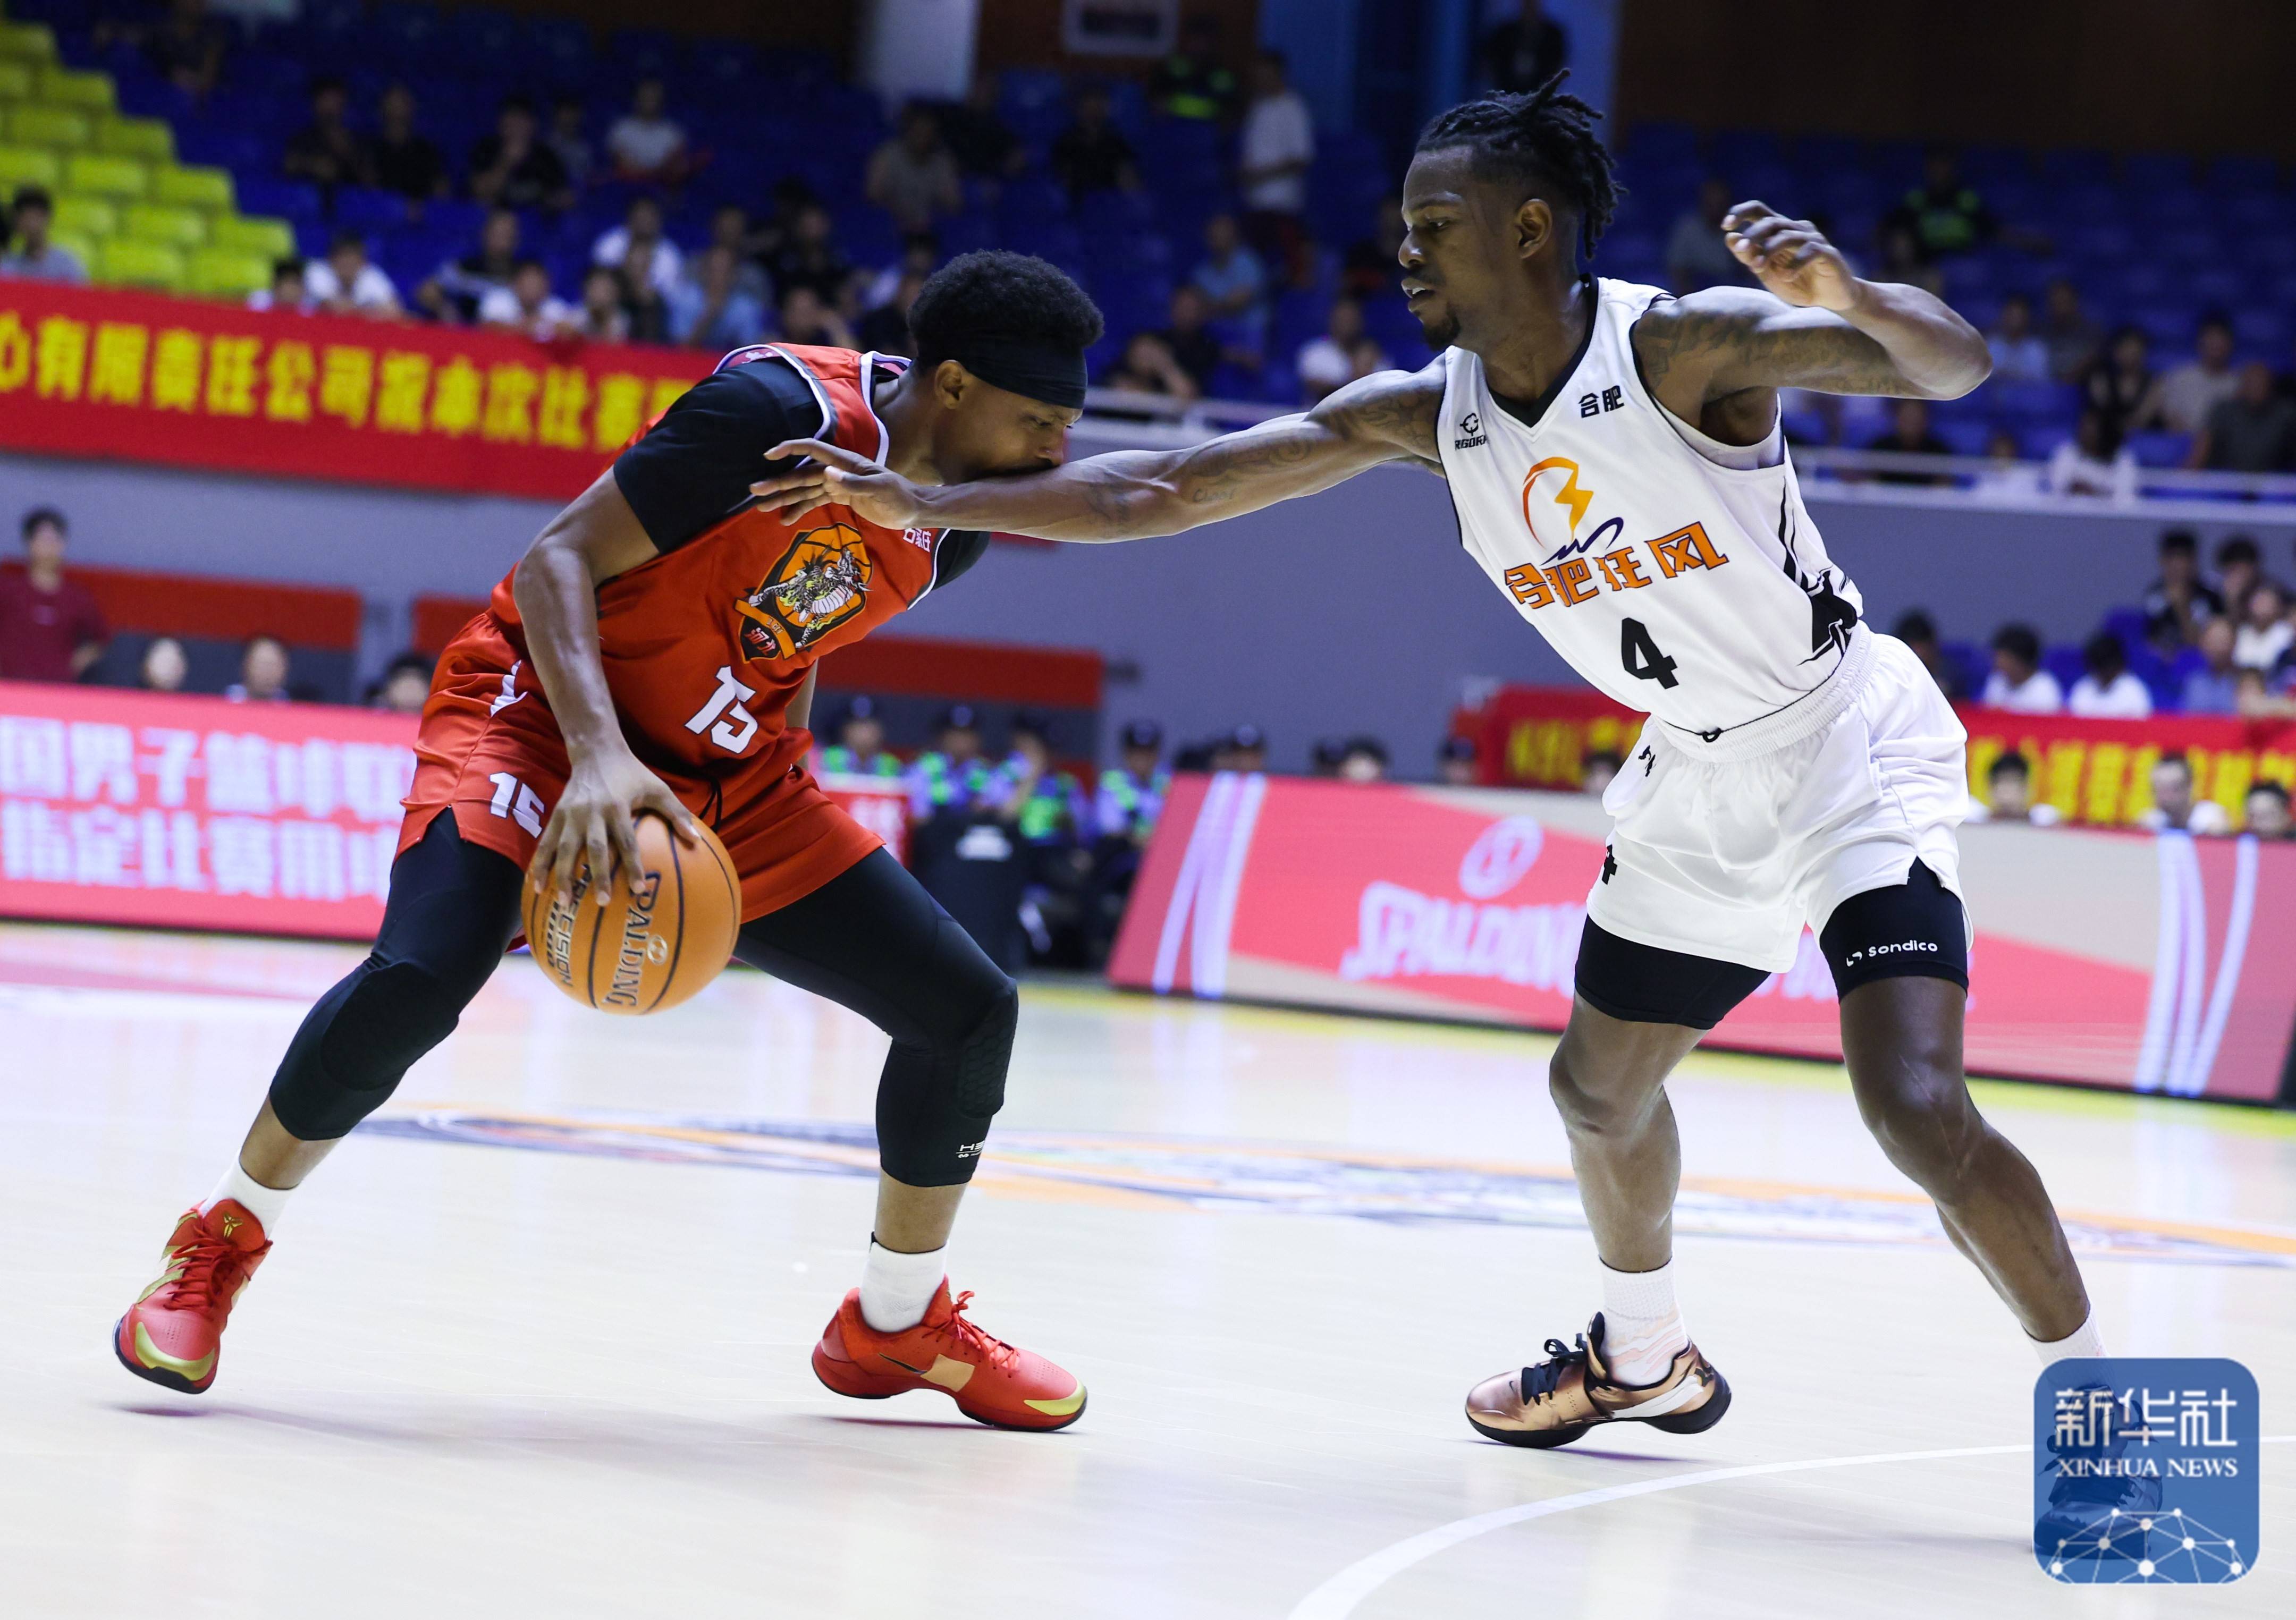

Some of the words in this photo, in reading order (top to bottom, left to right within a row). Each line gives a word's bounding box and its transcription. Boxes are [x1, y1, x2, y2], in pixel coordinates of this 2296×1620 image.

[1578, 385, 1625, 418] 合肥
[1504, 521, 1729, 610] 合肥狂风
[1621, 617, 1678, 690] 4
[684, 665, 758, 754] 15
[1340, 880, 1588, 1000] SPALDIN
[1868, 939, 1938, 957] sondico
